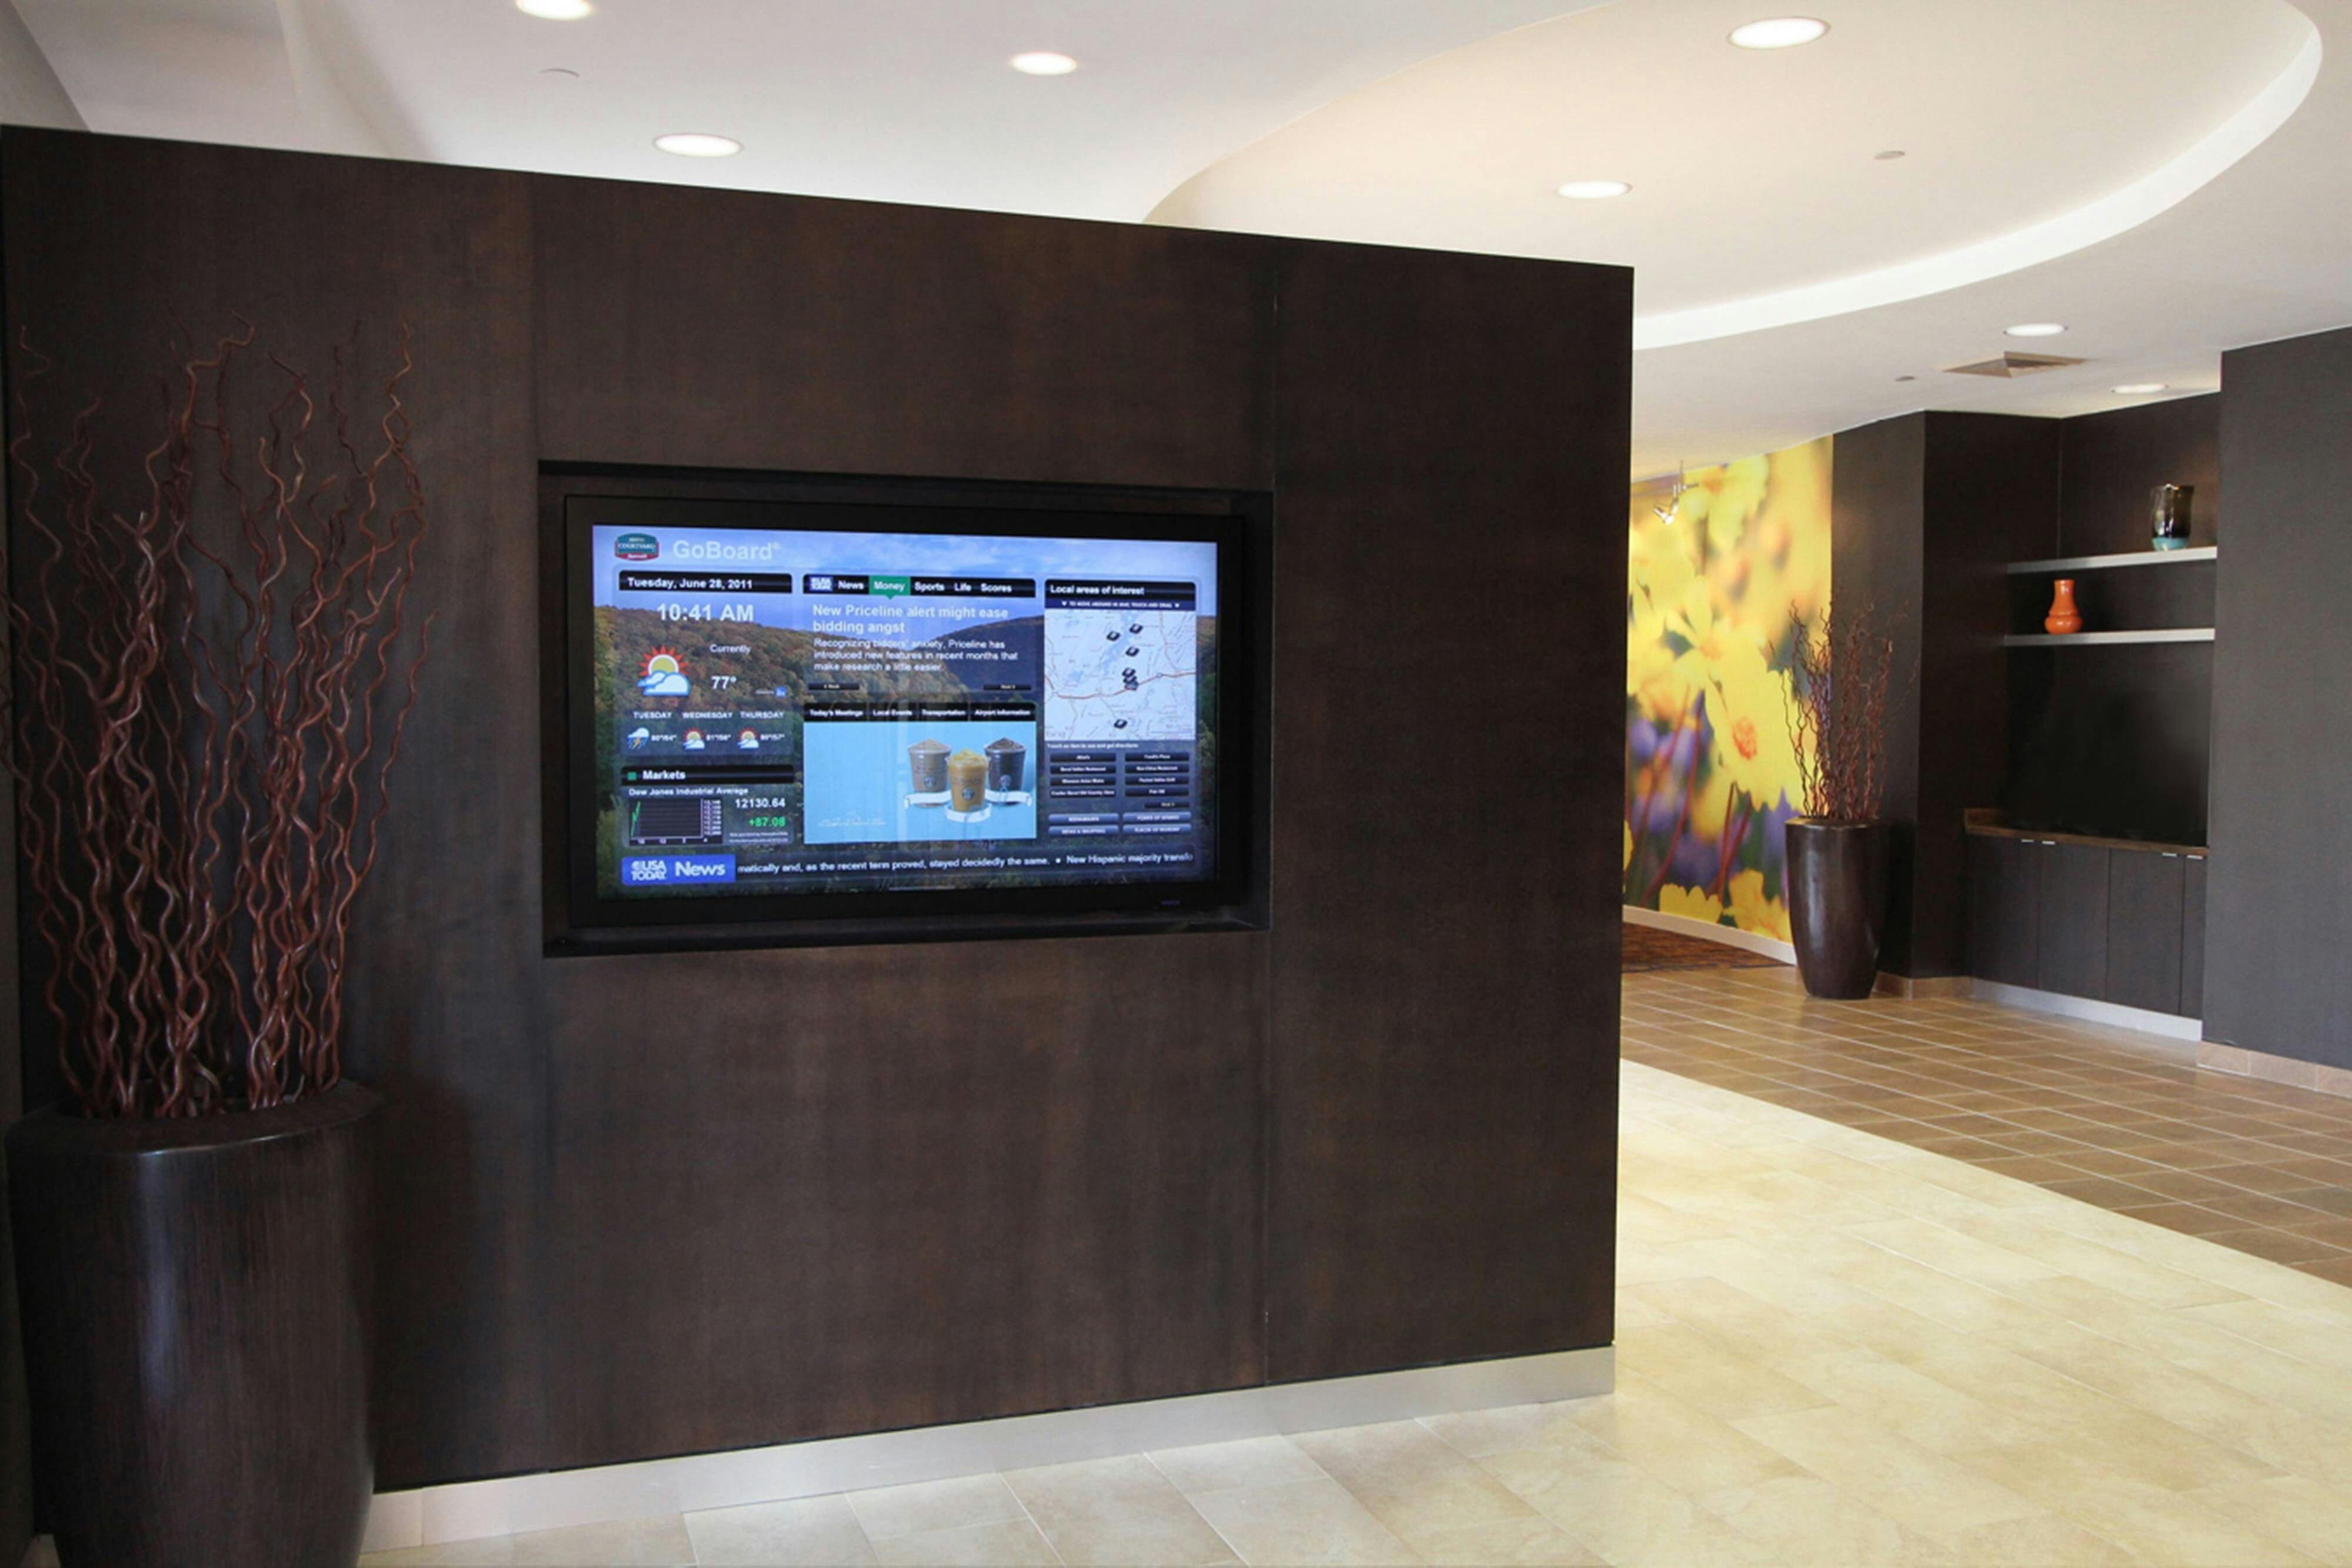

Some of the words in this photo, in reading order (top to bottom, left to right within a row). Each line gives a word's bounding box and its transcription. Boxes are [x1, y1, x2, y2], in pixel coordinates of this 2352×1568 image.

[627, 577, 677, 589] Tuesday,
[680, 579, 706, 588] June
[709, 579, 725, 590] 28,
[728, 579, 752, 589] 2011
[838, 580, 864, 590] News
[874, 581, 905, 592] Money
[914, 581, 945, 593] Sports
[954, 583, 971, 591] Life
[981, 583, 1012, 592] Scores
[1050, 585, 1074, 594] Local
[1102, 586, 1110, 594] of
[1112, 586, 1145, 595] interest
[657, 603, 712, 620] 10:41
[720, 604, 754, 621] AM
[813, 604, 841, 616] New
[846, 604, 903, 617] Priceline
[907, 606, 935, 617] alert
[939, 606, 976, 621] might
[979, 608, 1008, 618] ease
[813, 621, 864, 634] bidding
[868, 622, 906, 634] angst
[814, 638, 871, 649] Recognizing
[912, 640, 946, 650] anxiety,
[948, 640, 987, 648] Priceline
[988, 640, 1005, 648] has
[710, 644, 751, 655] Currently
[814, 651, 863, 659] introduced
[886, 651, 922, 659] features
[936, 651, 964, 660] recent
[965, 651, 998, 660] months
[1001, 652, 1018, 660] that
[814, 663, 840, 671] make
[842, 663, 882, 671] research
[810, 708, 834, 717] Today's
[834, 709, 864, 717] Meetings
[921, 708, 966, 717] Transportation
[643, 771, 686, 780] Markets
[716, 787, 749, 795] Average
[736, 798, 786, 808] 12130.64
[748, 817, 786, 827] +87.08
[737, 862, 780, 874] matically
[782, 862, 803, 873] and,
[820, 862, 835, 871] the
[837, 862, 867, 870] recent
[892, 860, 927, 871] proved,
[929, 858, 960, 870] stayed
[961, 857, 1005, 868] decidedly
[1007, 857, 1022, 865] the
[1067, 855, 1087, 864] New
[1088, 854, 1125, 865] Hispanic
[1128, 853, 1161, 864] majority
[676, 862, 726, 877] News
[631, 870, 667, 881] TODAY
